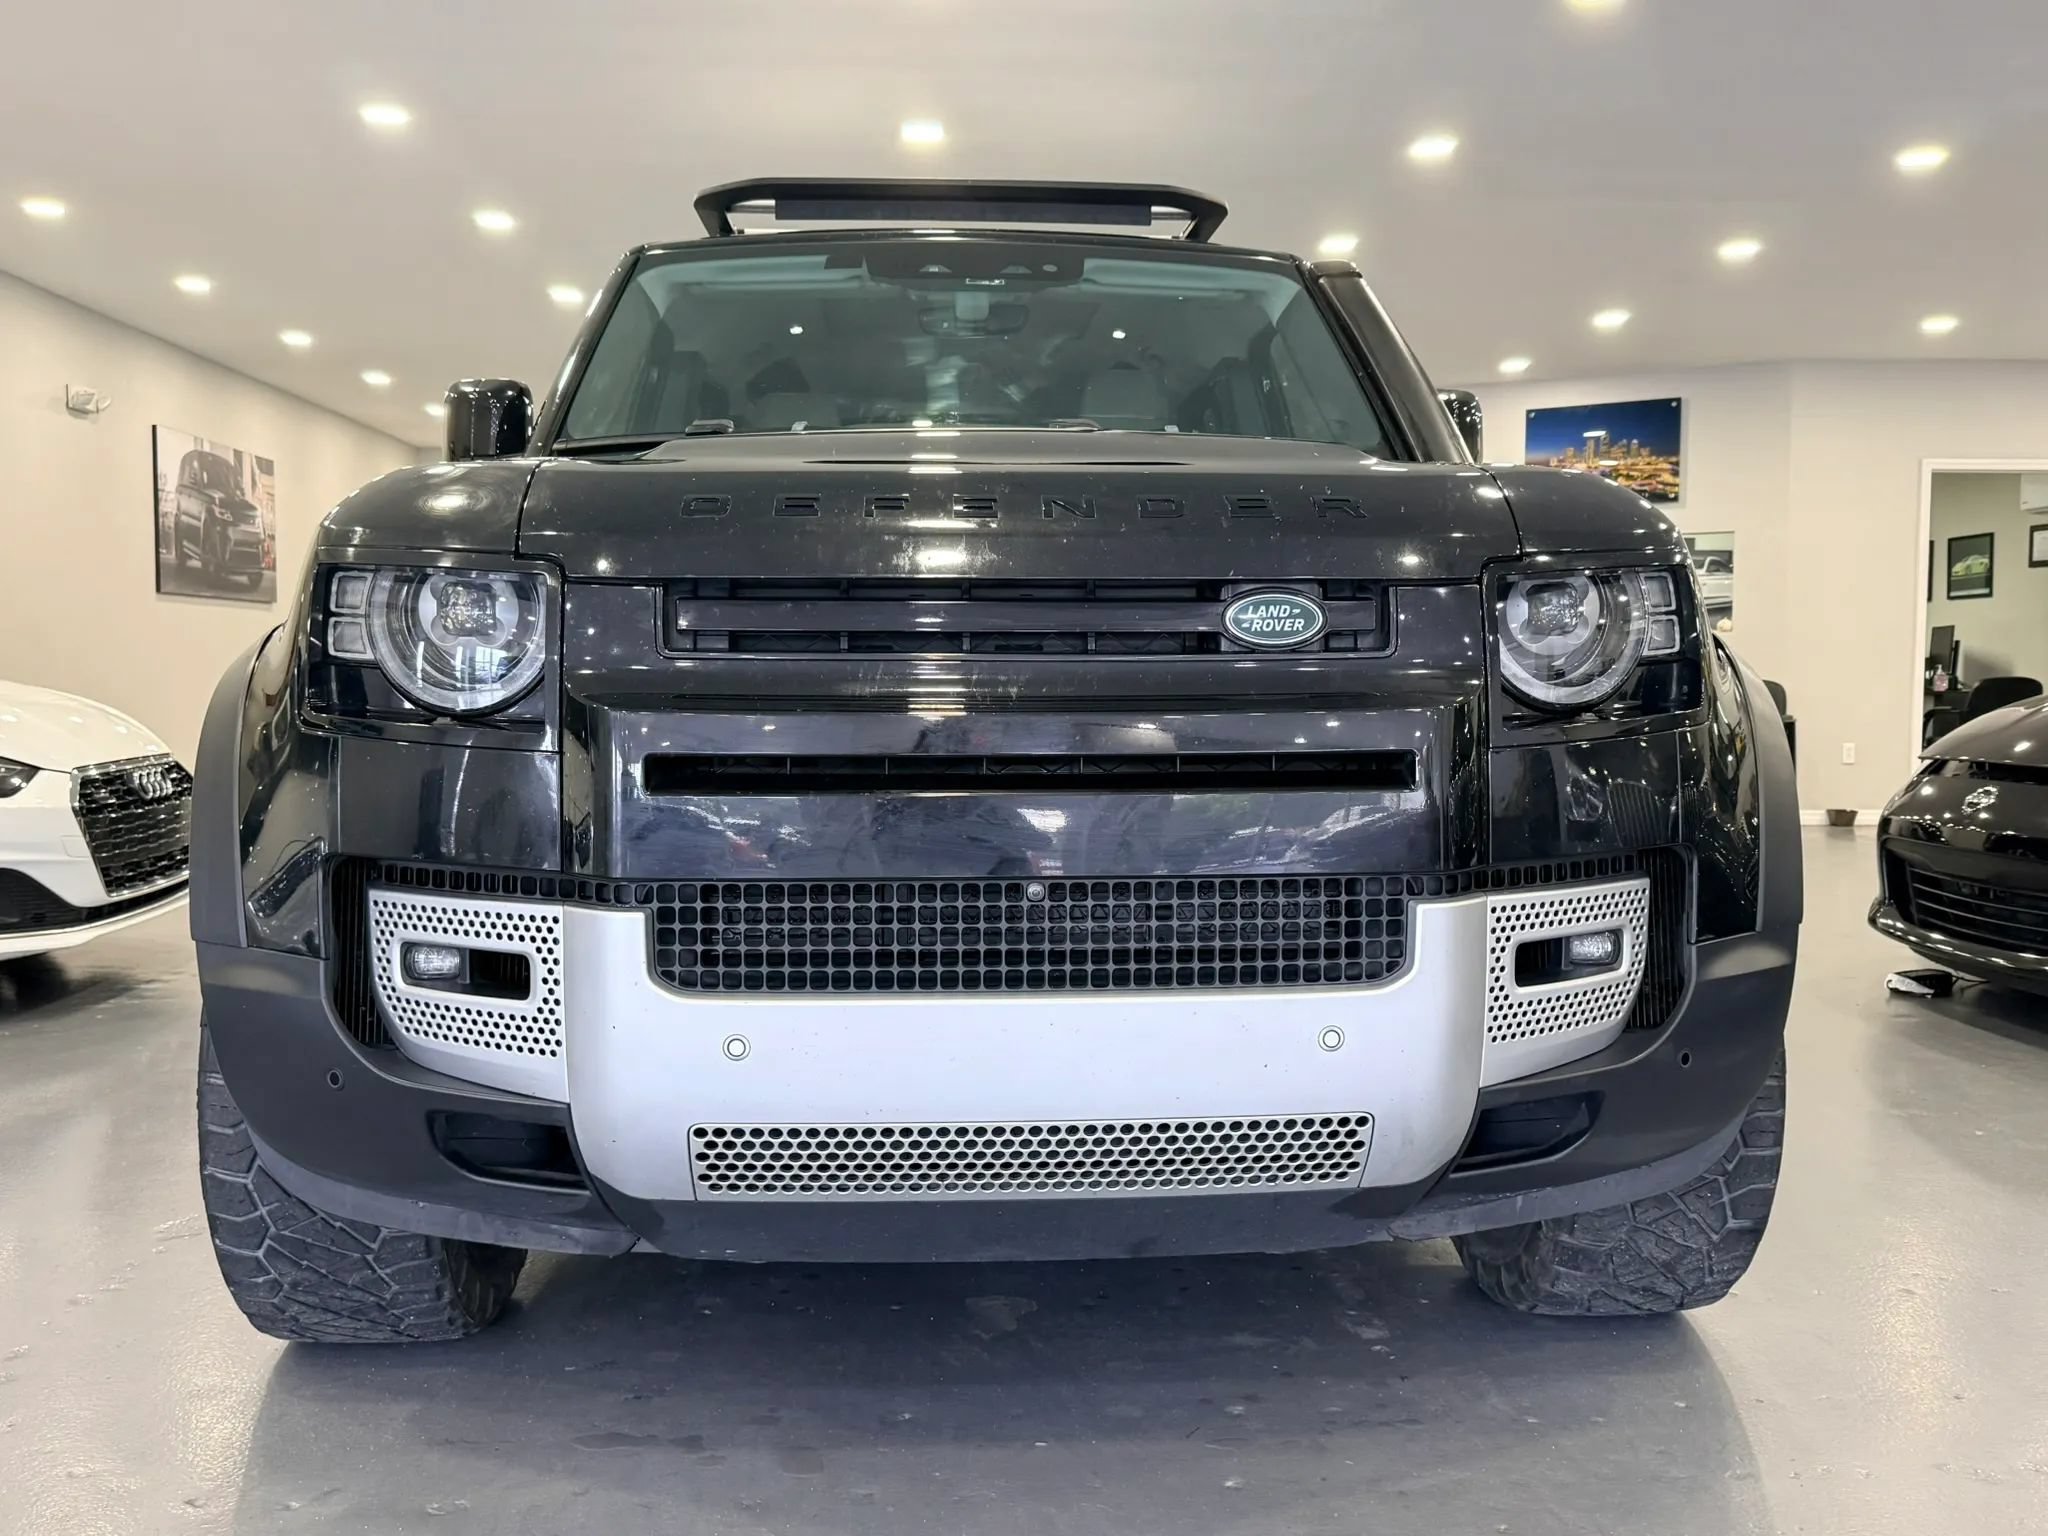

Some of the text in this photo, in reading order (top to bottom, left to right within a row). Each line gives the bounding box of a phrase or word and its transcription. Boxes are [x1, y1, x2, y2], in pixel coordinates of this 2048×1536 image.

[679, 493, 1368, 519] DEFENDER
[1246, 605, 1291, 618] LAND
[1251, 619, 1305, 632] ROVER
